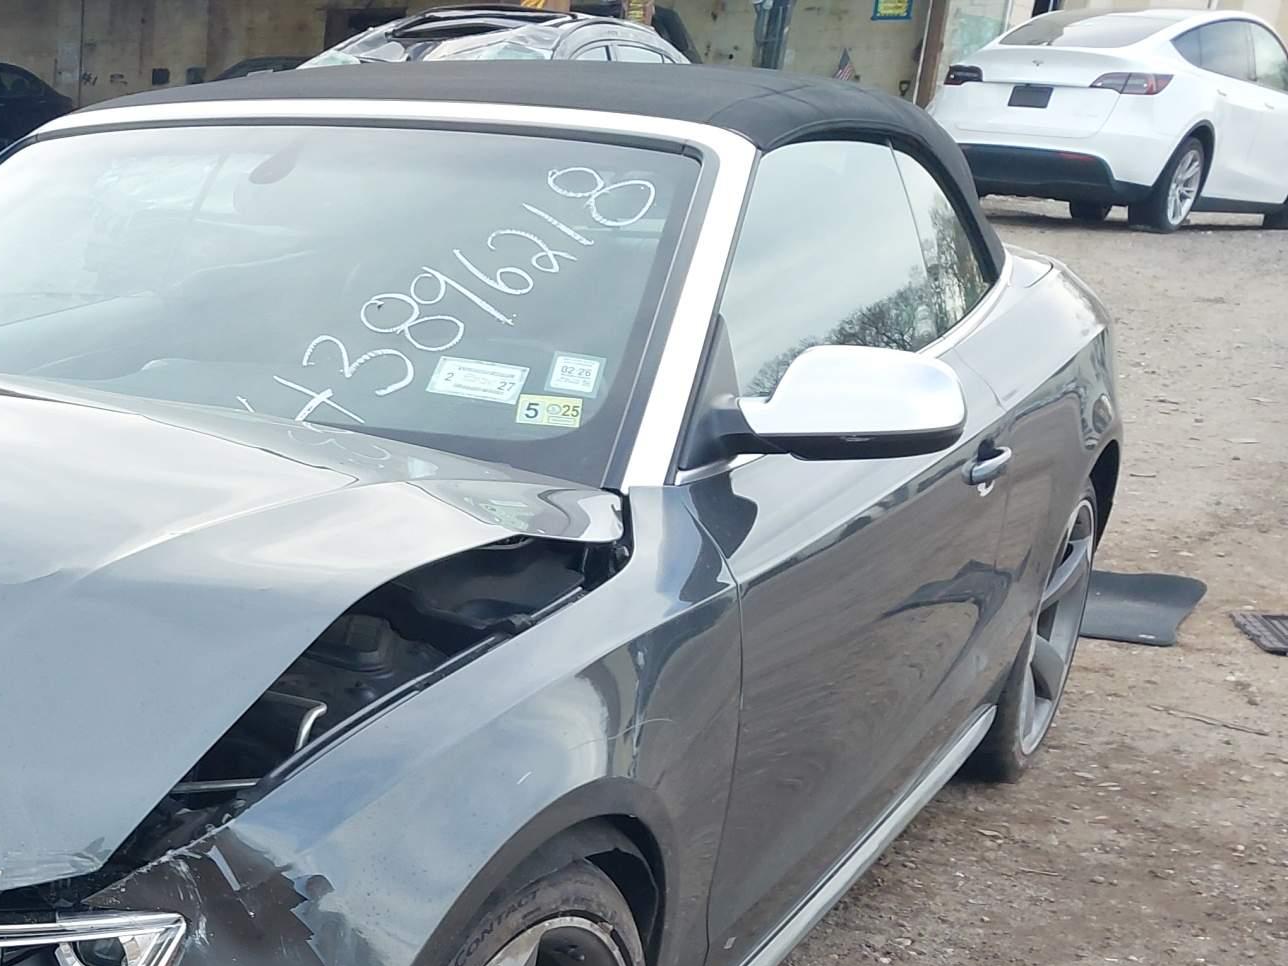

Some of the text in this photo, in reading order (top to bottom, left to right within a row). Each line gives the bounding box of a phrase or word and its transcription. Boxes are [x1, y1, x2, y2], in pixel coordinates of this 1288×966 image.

[497, 381, 516, 392] 27
[525, 402, 580, 419] 5 25
